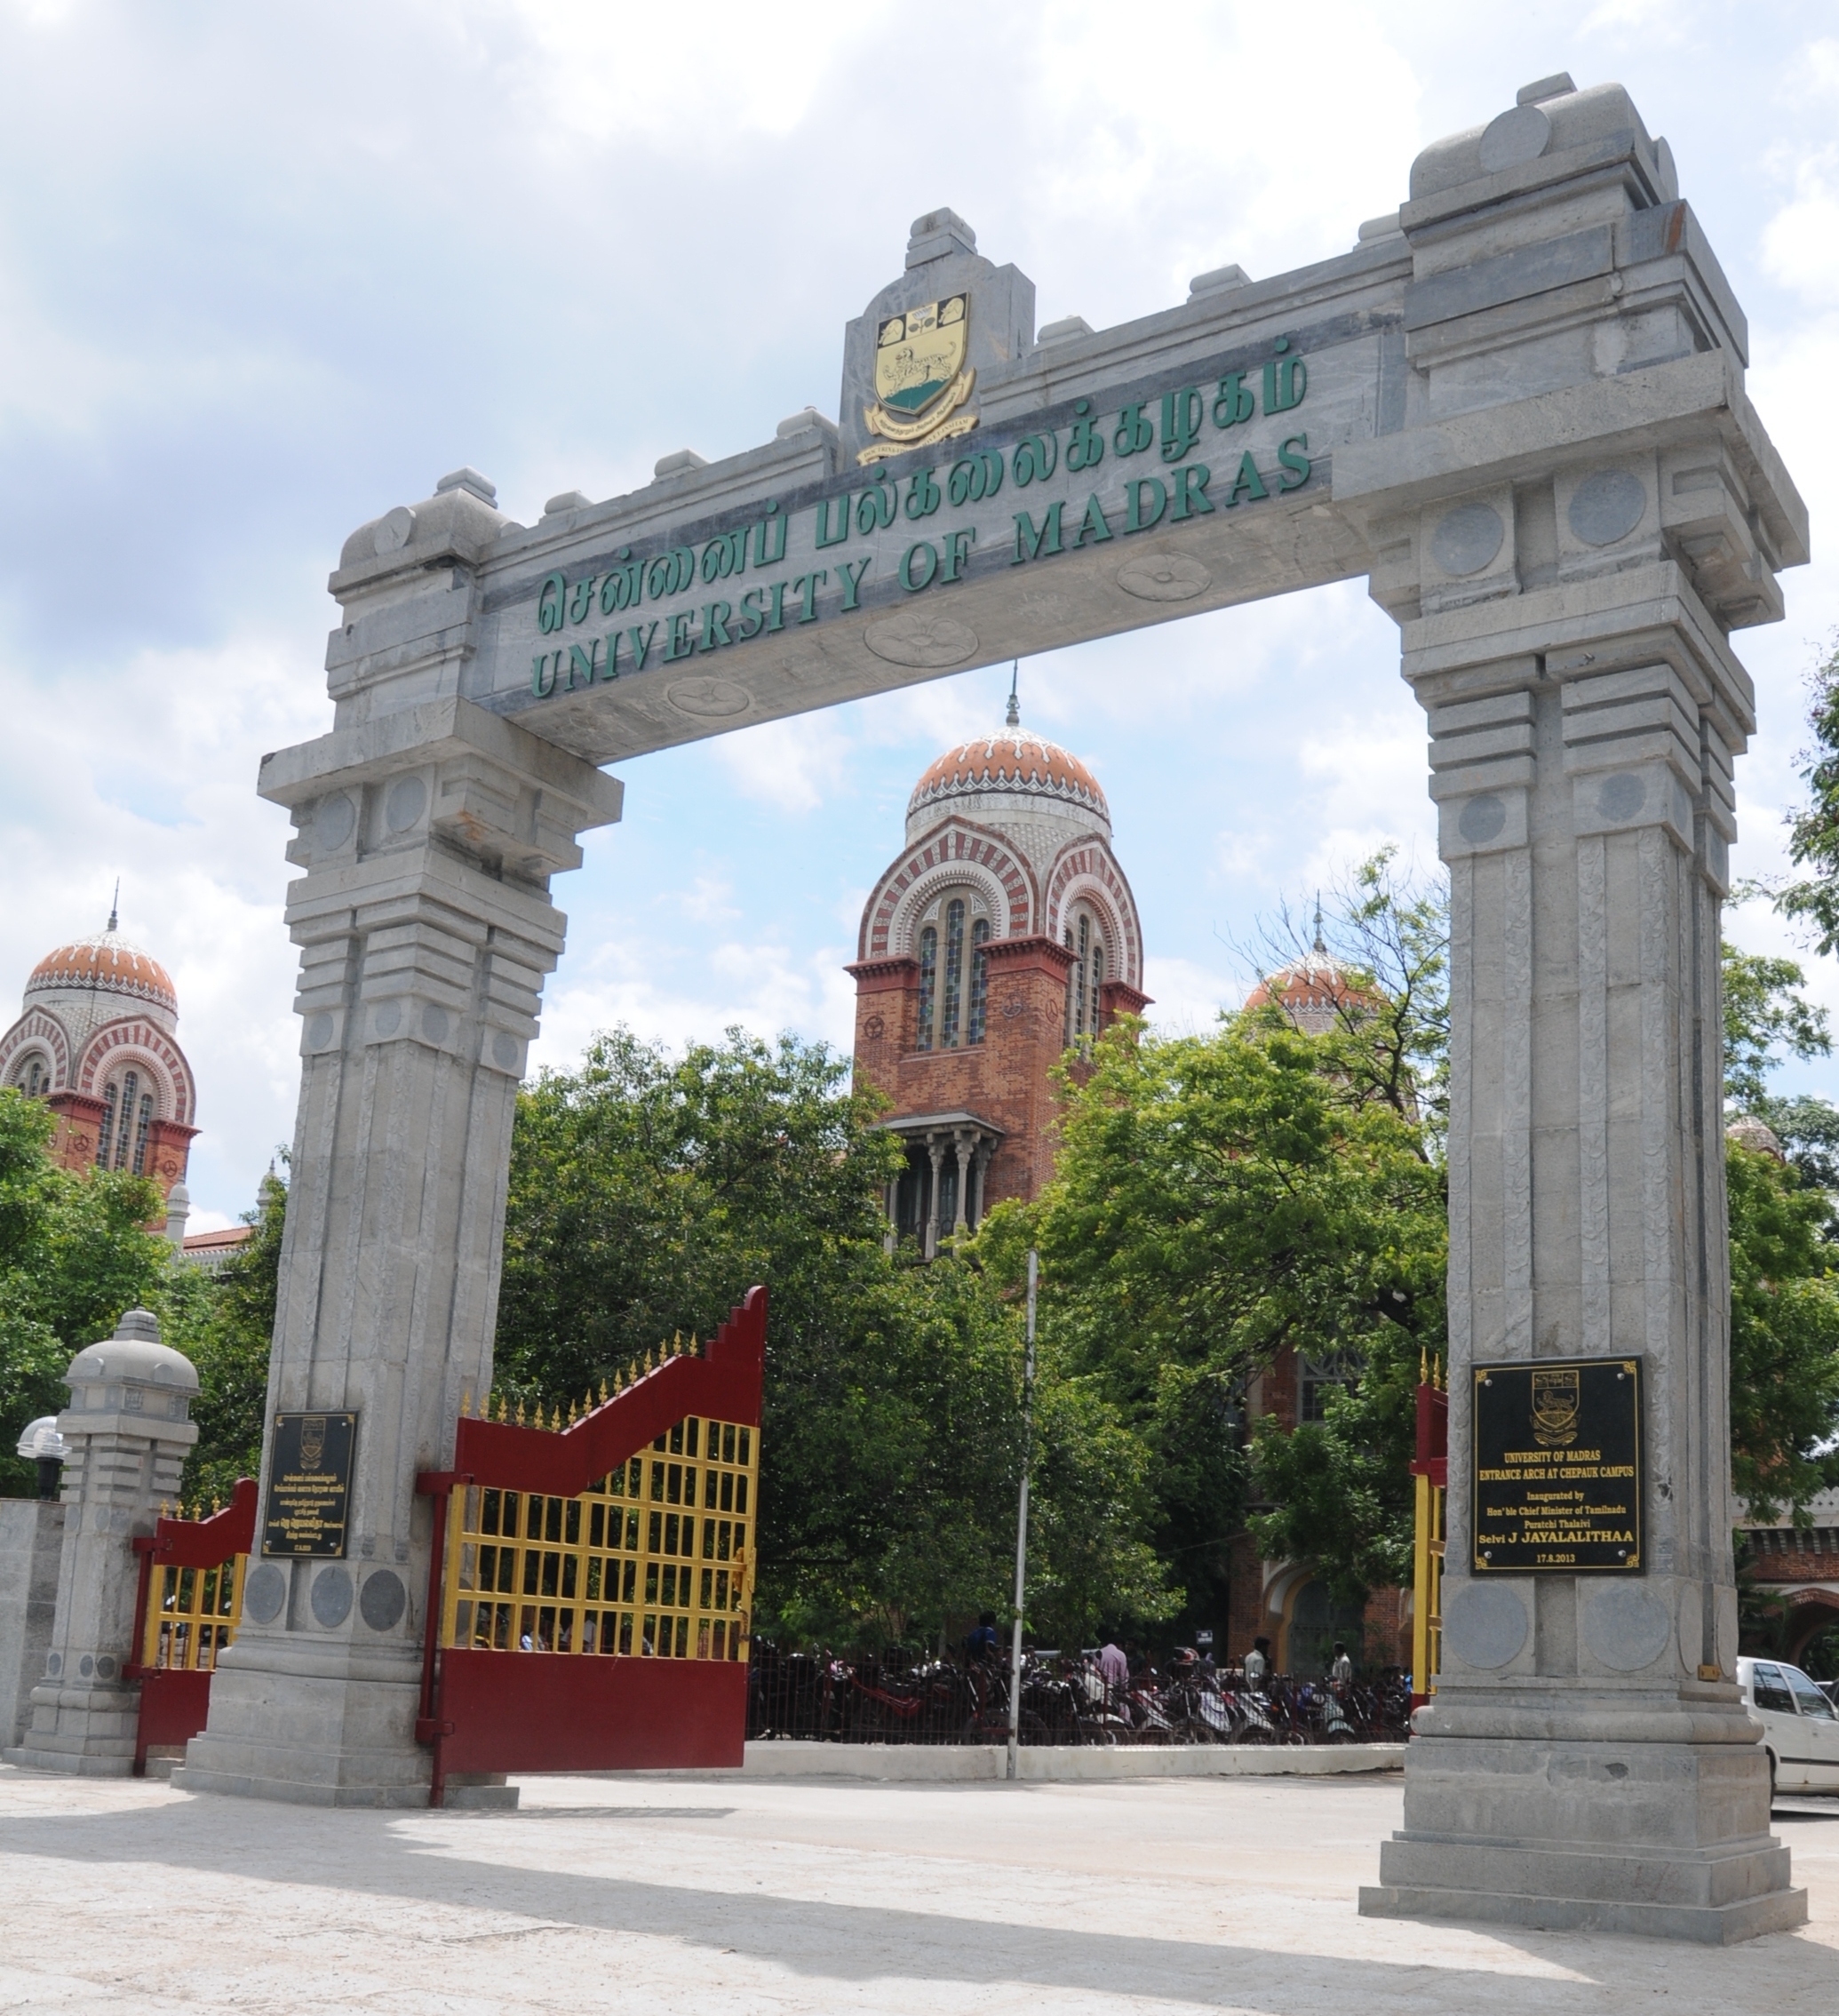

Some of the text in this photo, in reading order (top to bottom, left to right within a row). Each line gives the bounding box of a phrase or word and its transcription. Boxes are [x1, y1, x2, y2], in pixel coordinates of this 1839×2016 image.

[537, 338, 1308, 636] சென்னைப் பல்கலைக்கழகம்
[532, 434, 1312, 698] UNIVERSITY OF MADRAS
[1504, 1449, 1601, 1463] UNIVERSITY OF MADRAS
[1479, 1465, 1635, 1481] ENTRANCE ARCH AT CHEPAUK CAMPUS
[1526, 1490, 1584, 1503] Inaugurated by
[1518, 1506, 1540, 1516] Chief
[1540, 1506, 1573, 1516] Minister
[1574, 1505, 1583, 1515] of
[1584, 1504, 1627, 1515] Tamilnadu
[1524, 1518, 1591, 1529] Puratchi Thalaivi
[1479, 1530, 1635, 1544] Selvi J JAYALALITHAA
[1536, 1553, 1576, 1564] 17.8.2013
